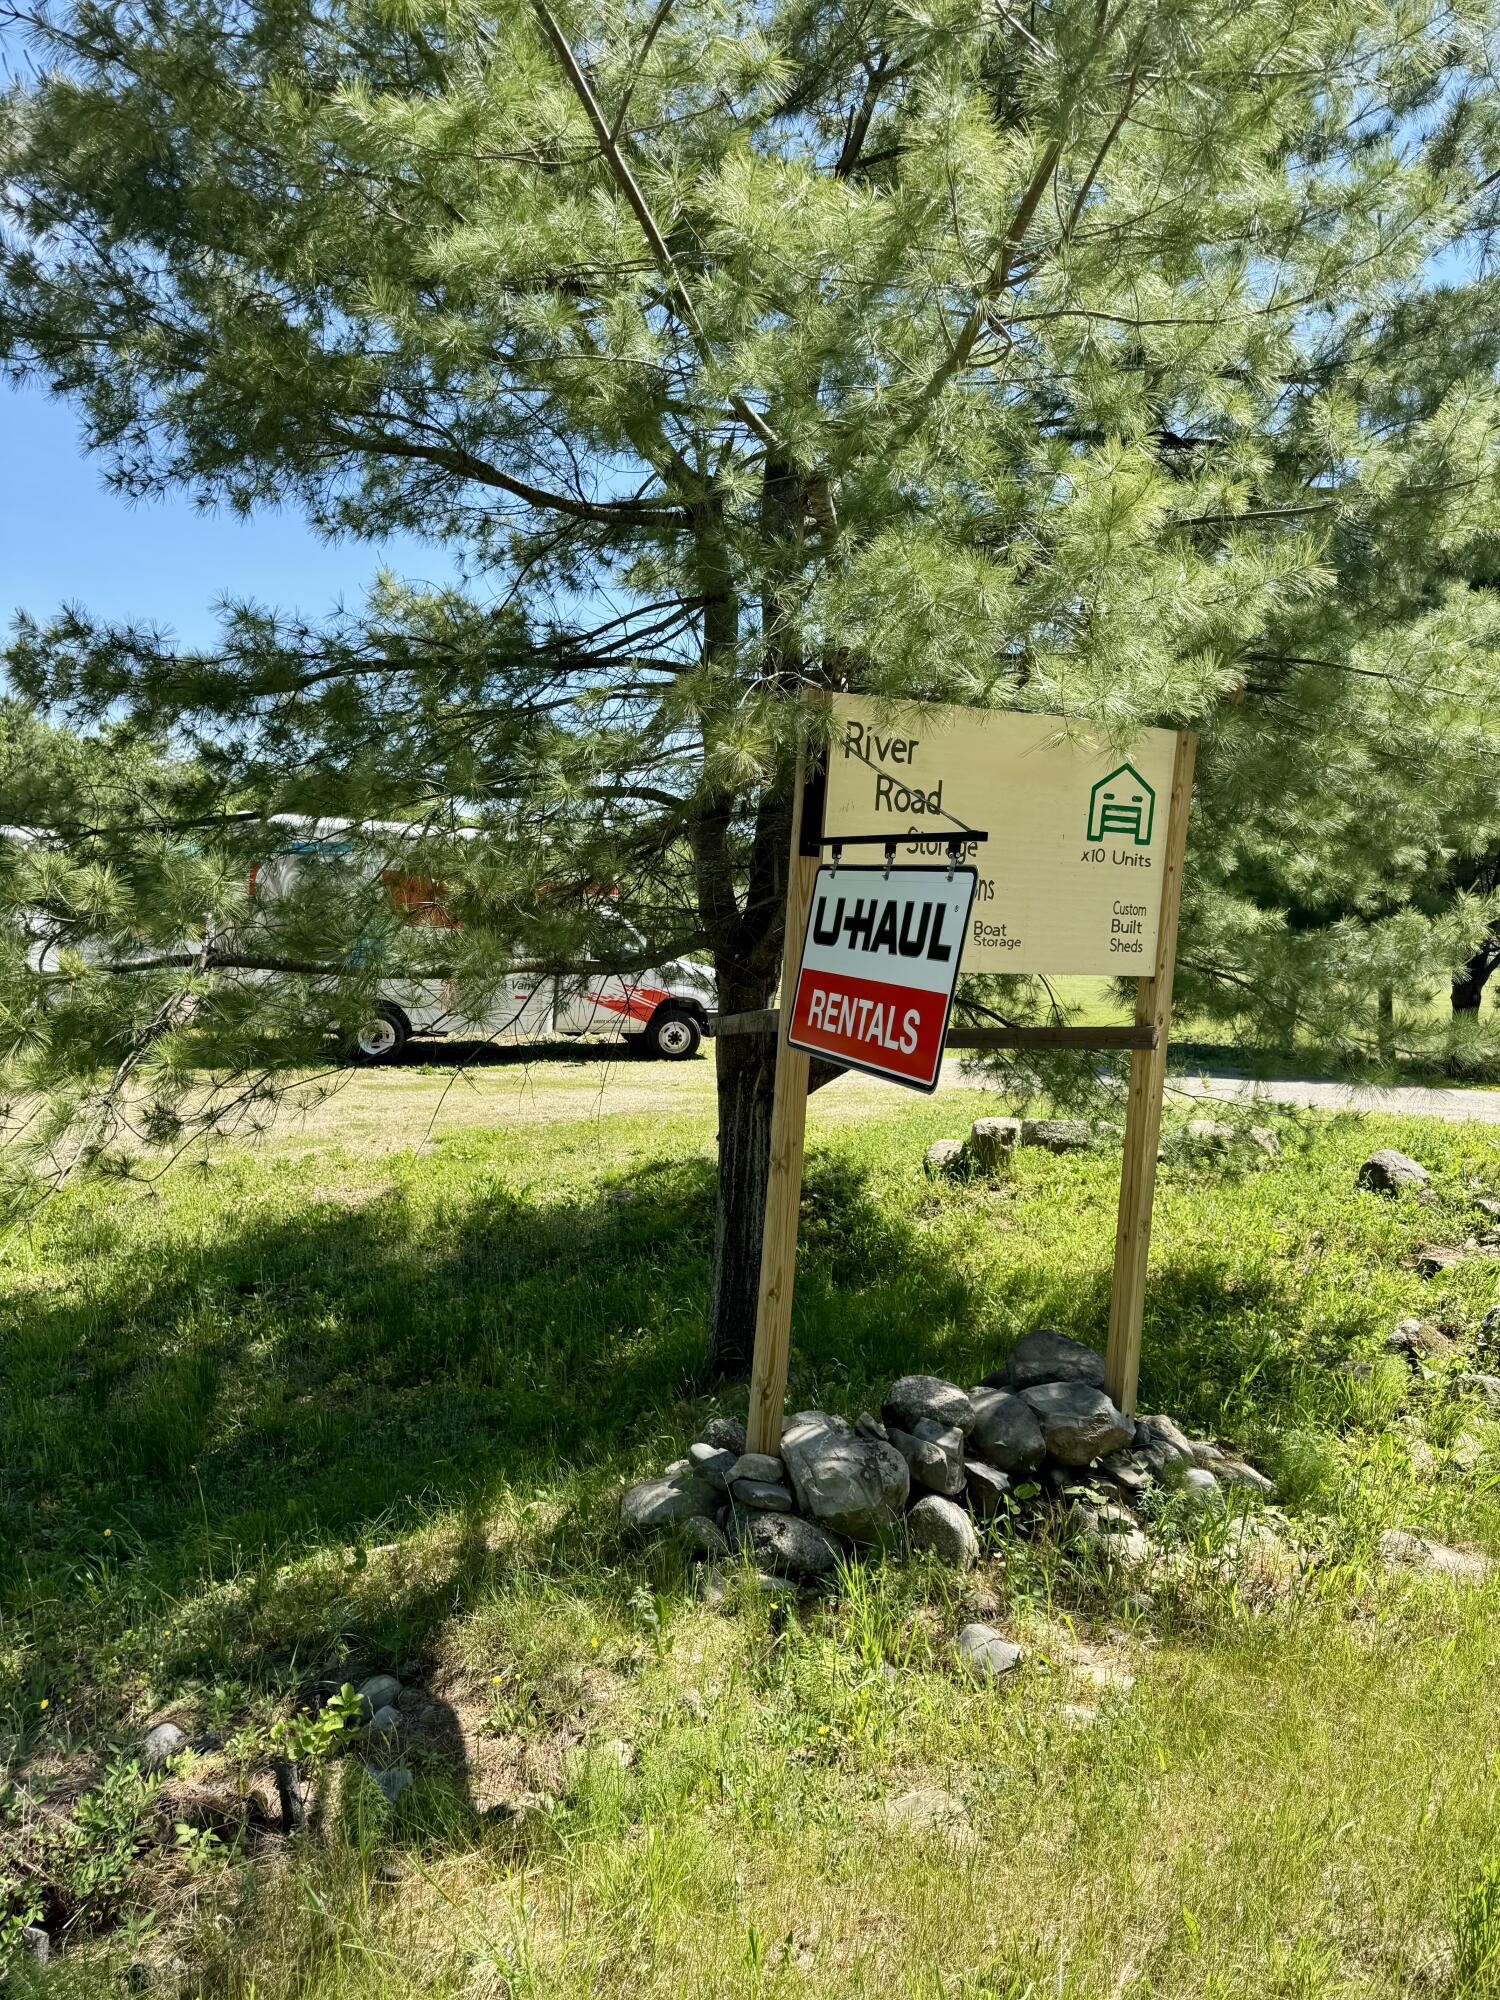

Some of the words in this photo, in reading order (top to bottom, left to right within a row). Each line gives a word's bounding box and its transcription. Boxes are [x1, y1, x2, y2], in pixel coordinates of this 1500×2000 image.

[844, 720, 920, 765] River
[874, 773, 943, 816] Road
[1080, 848, 1106, 863] x10
[1112, 850, 1152, 868] Units
[1112, 900, 1147, 917] Custom
[812, 895, 953, 963] U-HAUL
[973, 920, 1007, 937] Boat
[1110, 918, 1143, 935] Built
[973, 935, 1022, 950] Storage
[1109, 937, 1144, 954] Sheds
[807, 988, 921, 1055] RENTALS
